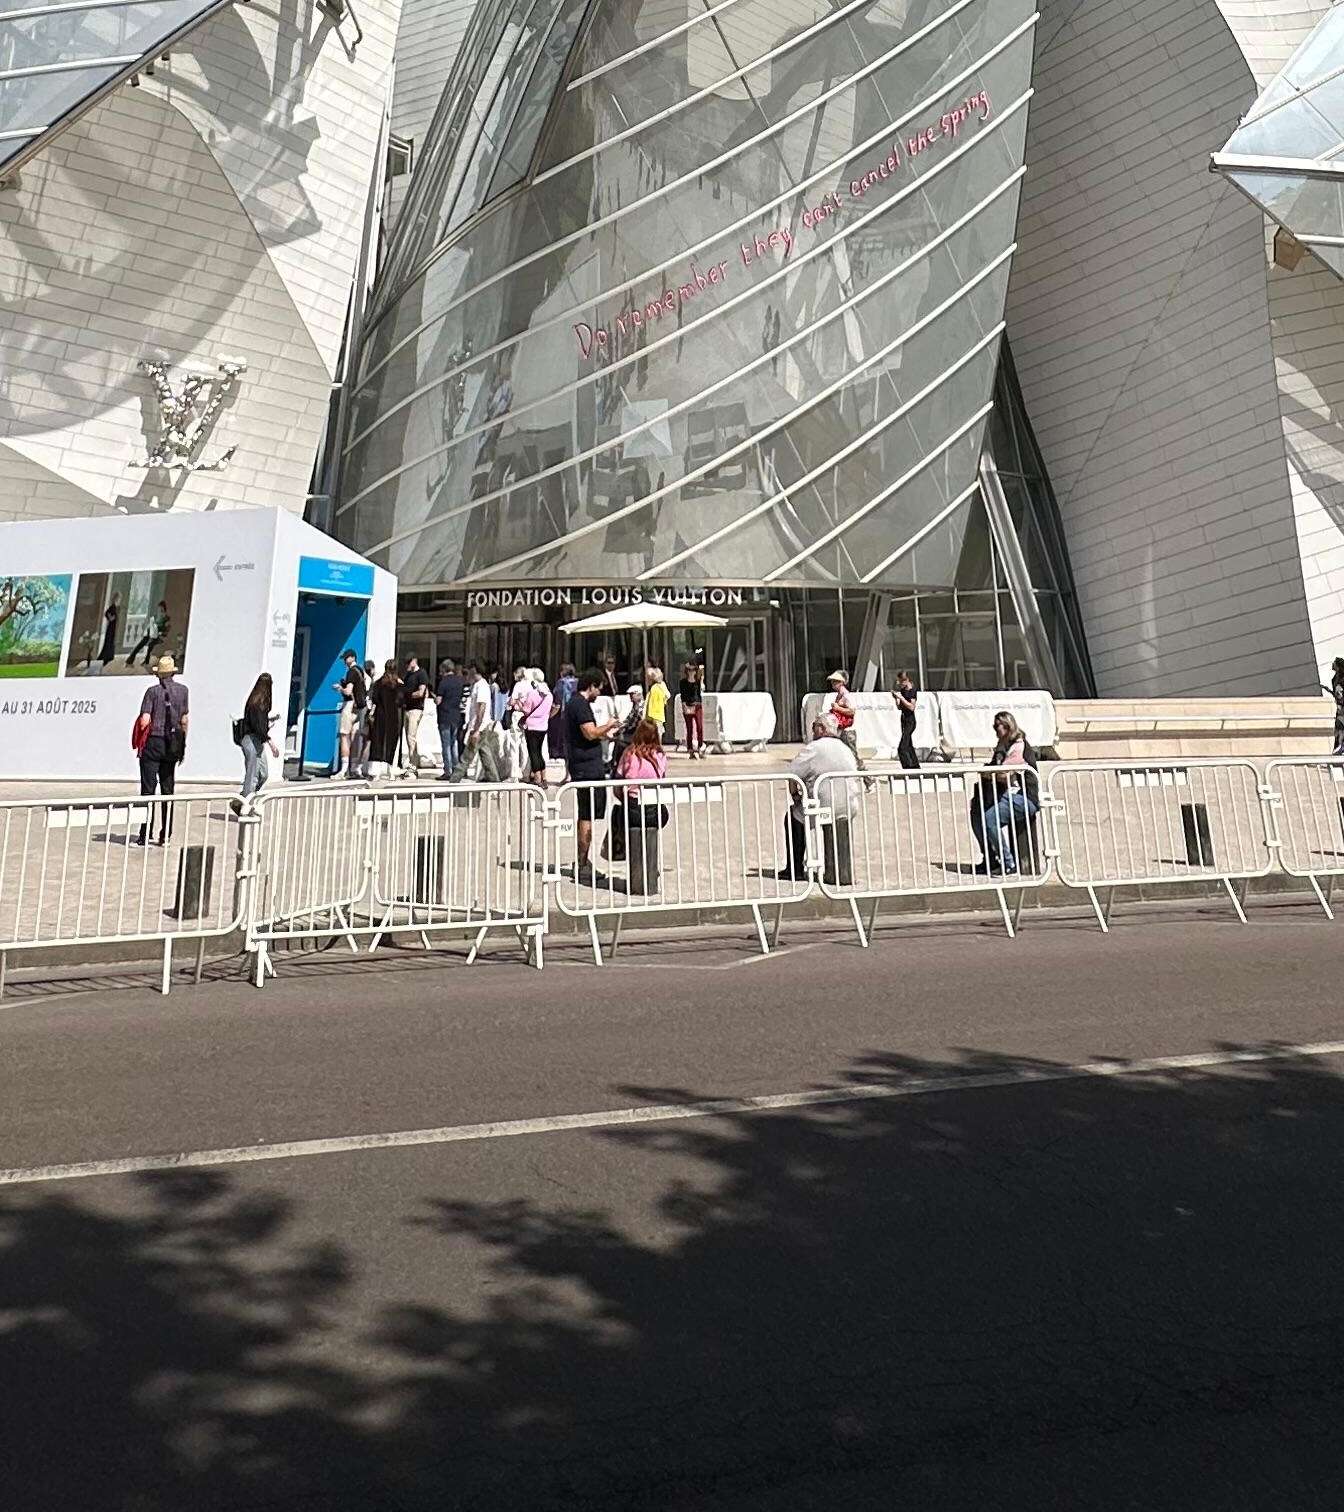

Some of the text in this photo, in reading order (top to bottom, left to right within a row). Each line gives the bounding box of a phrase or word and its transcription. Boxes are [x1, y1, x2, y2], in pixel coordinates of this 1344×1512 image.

[573, 90, 990, 360] Do remember they can't cancel the spring
[467, 586, 743, 608] FONDATION LOUIS VUITTON
[2, 701, 18, 714] AU
[21, 701, 33, 714] 31
[36, 697, 69, 714] AOÛT
[71, 700, 97, 714] 2025
